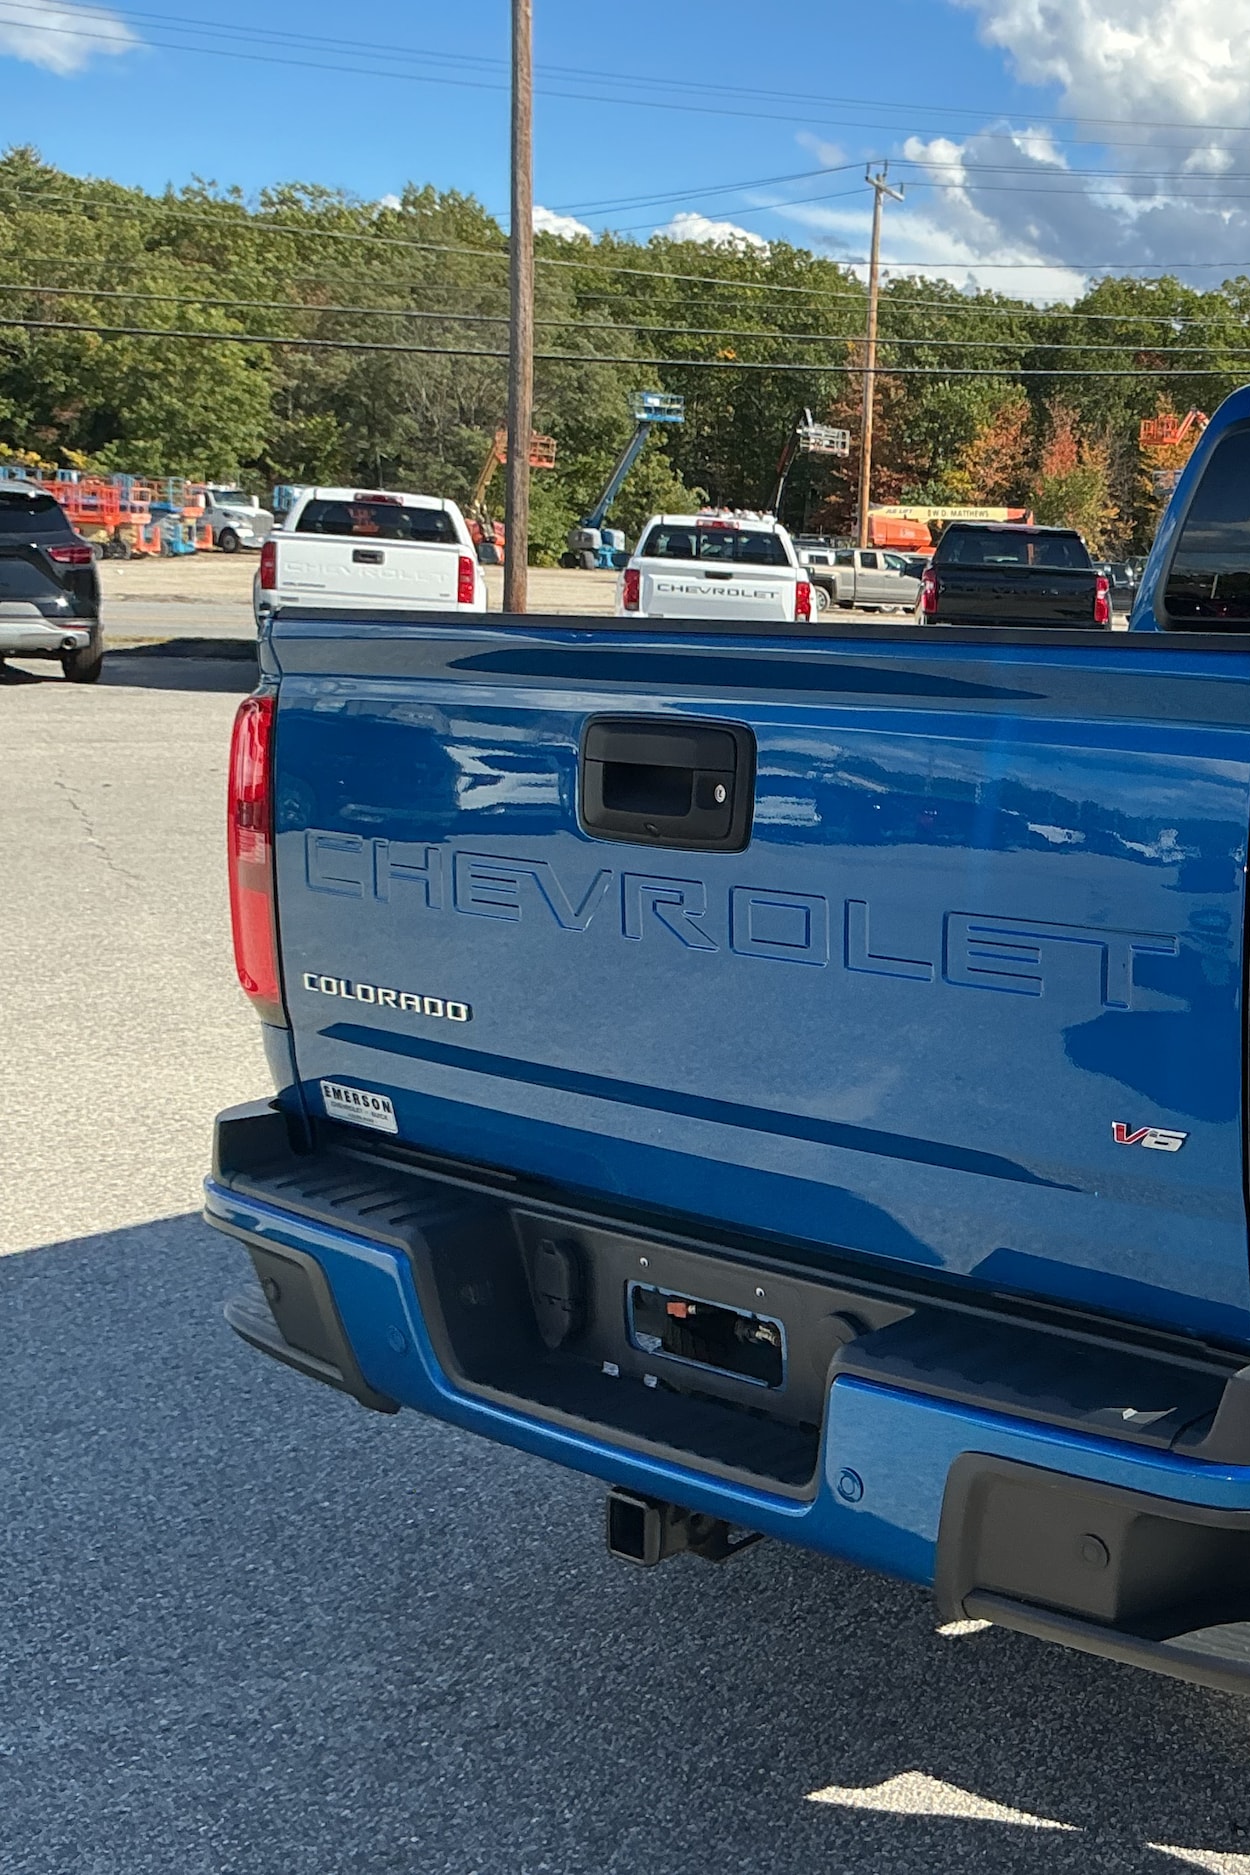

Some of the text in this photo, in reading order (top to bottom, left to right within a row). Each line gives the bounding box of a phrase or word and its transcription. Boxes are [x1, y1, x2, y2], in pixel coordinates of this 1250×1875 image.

[950, 509, 990, 518] MATTHEWS
[657, 583, 780, 599] CHEVROLET
[304, 828, 1180, 1010] CHEVROLET
[303, 972, 471, 1022] COLORADO
[323, 1085, 393, 1114] EMERSON
[1111, 1121, 1188, 1152] V6
